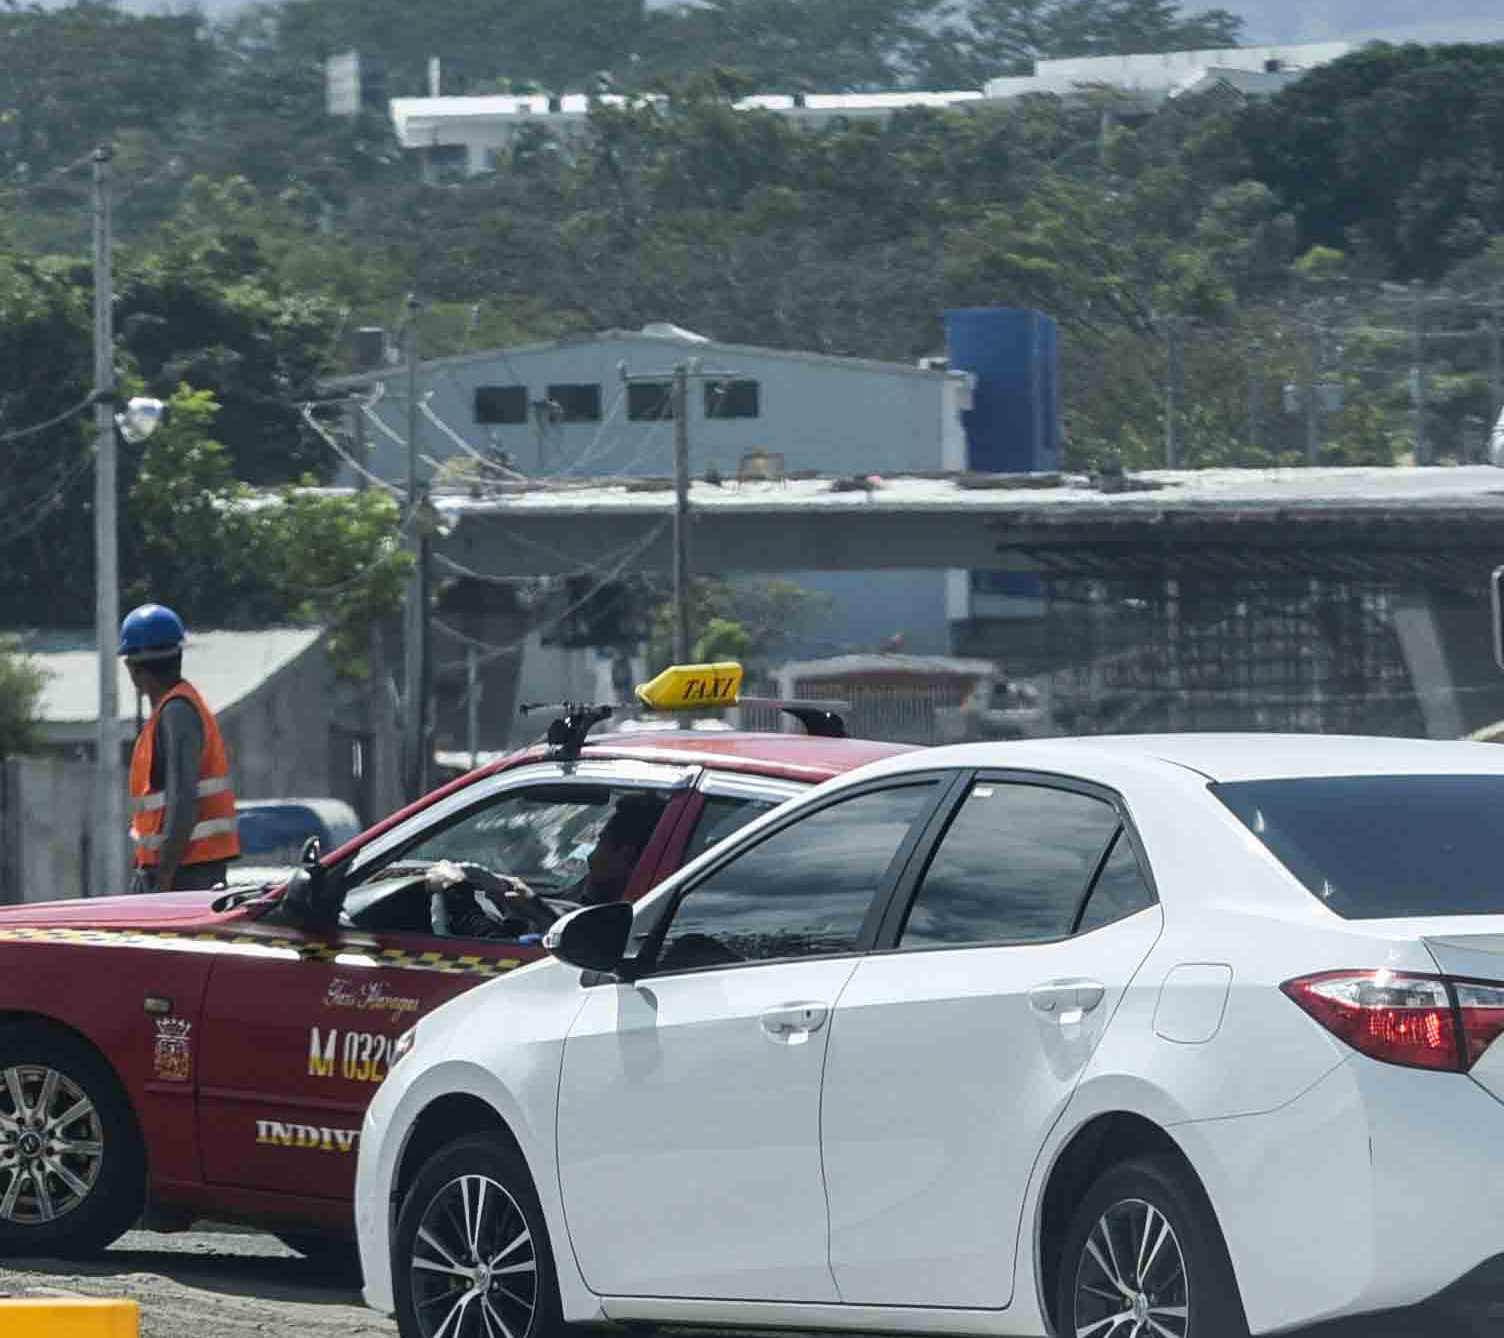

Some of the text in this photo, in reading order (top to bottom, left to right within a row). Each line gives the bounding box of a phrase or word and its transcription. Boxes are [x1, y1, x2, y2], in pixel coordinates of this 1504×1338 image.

[682, 676, 734, 700] TAXI
[308, 1026, 338, 1077] M
[255, 1120, 361, 1153] INDIV
